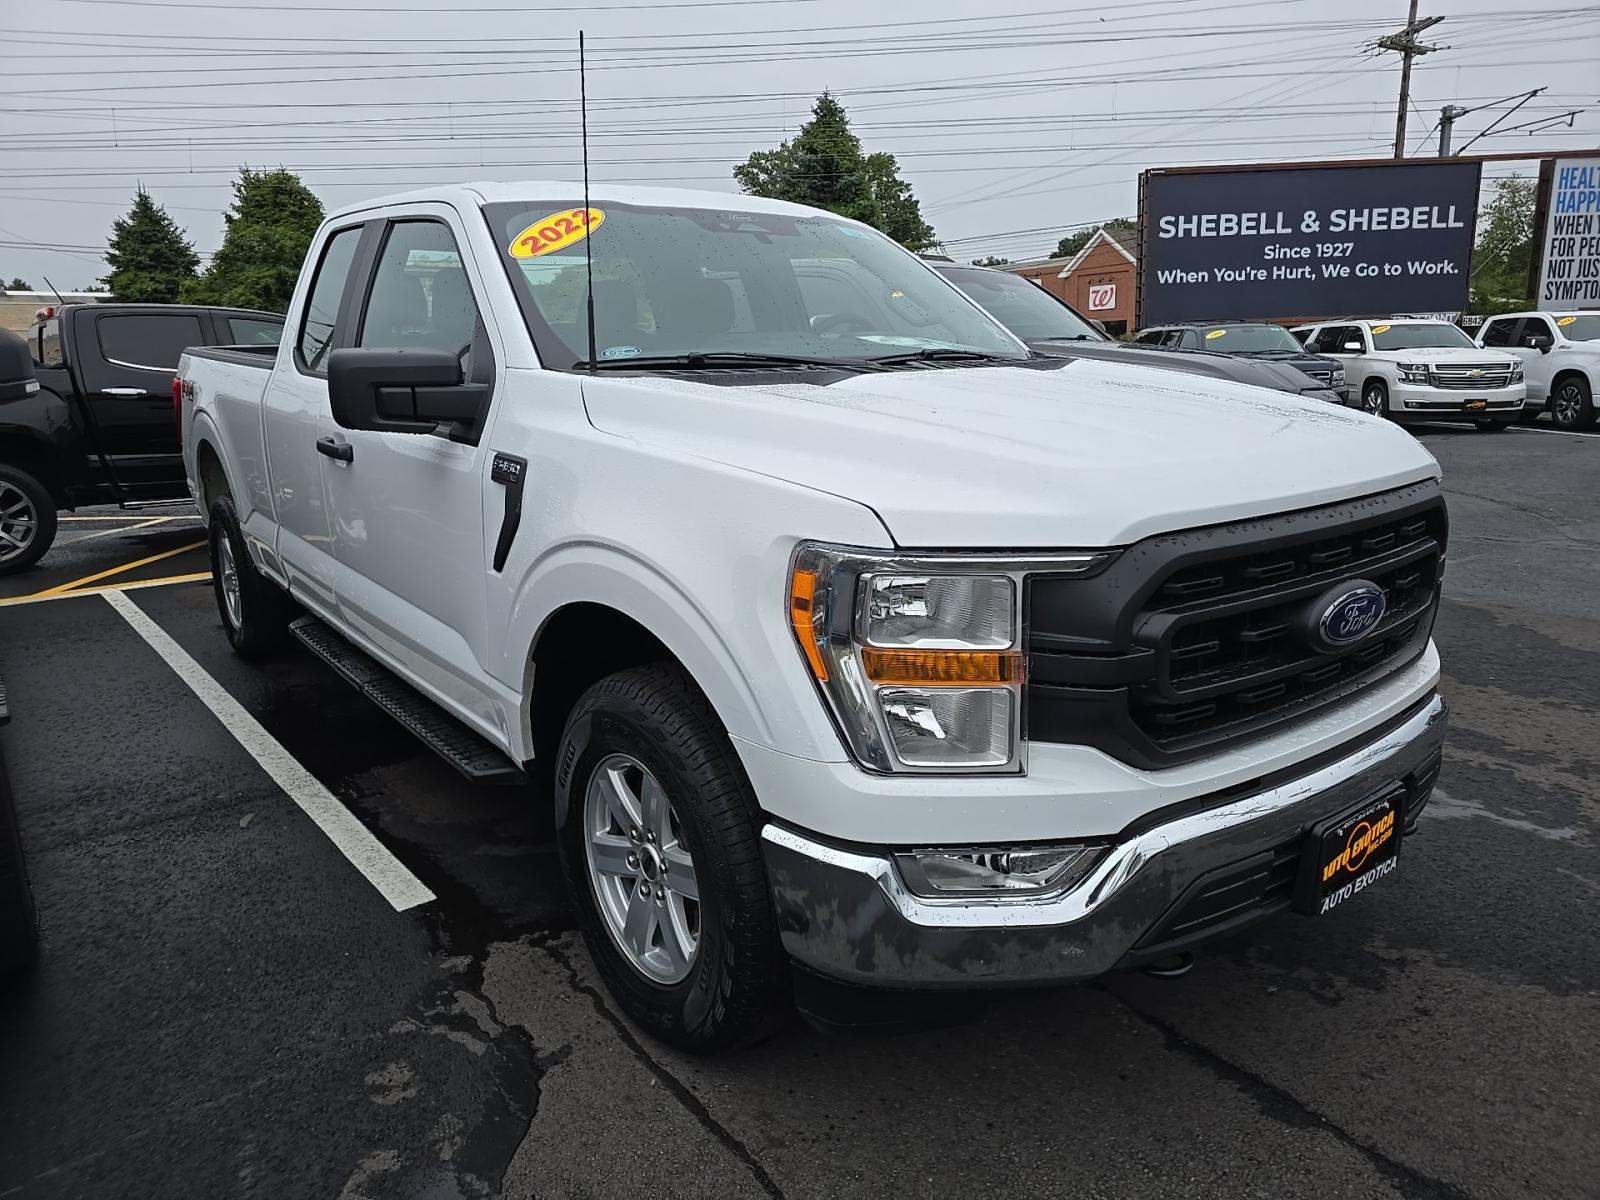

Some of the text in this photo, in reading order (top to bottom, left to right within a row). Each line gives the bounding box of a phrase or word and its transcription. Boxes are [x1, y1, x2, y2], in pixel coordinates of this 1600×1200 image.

[1558, 166, 1600, 190] HEAL
[521, 209, 598, 254] 2022
[1159, 205, 1464, 239] SHEBELL & SHEBELL
[1553, 214, 1593, 236] WHEN
[1263, 242, 1354, 260] Since 1927
[1550, 237, 1576, 257] FOR
[1157, 260, 1459, 284] When You're Hurt, We Go to Work.
[1547, 258, 1575, 279] NOT
[1544, 280, 1600, 300] SYMPTO
[1341, 600, 1375, 634] Ford
[1351, 810, 1395, 859] EXOTICA
[1320, 856, 1398, 915] AUTO EXOTICA
